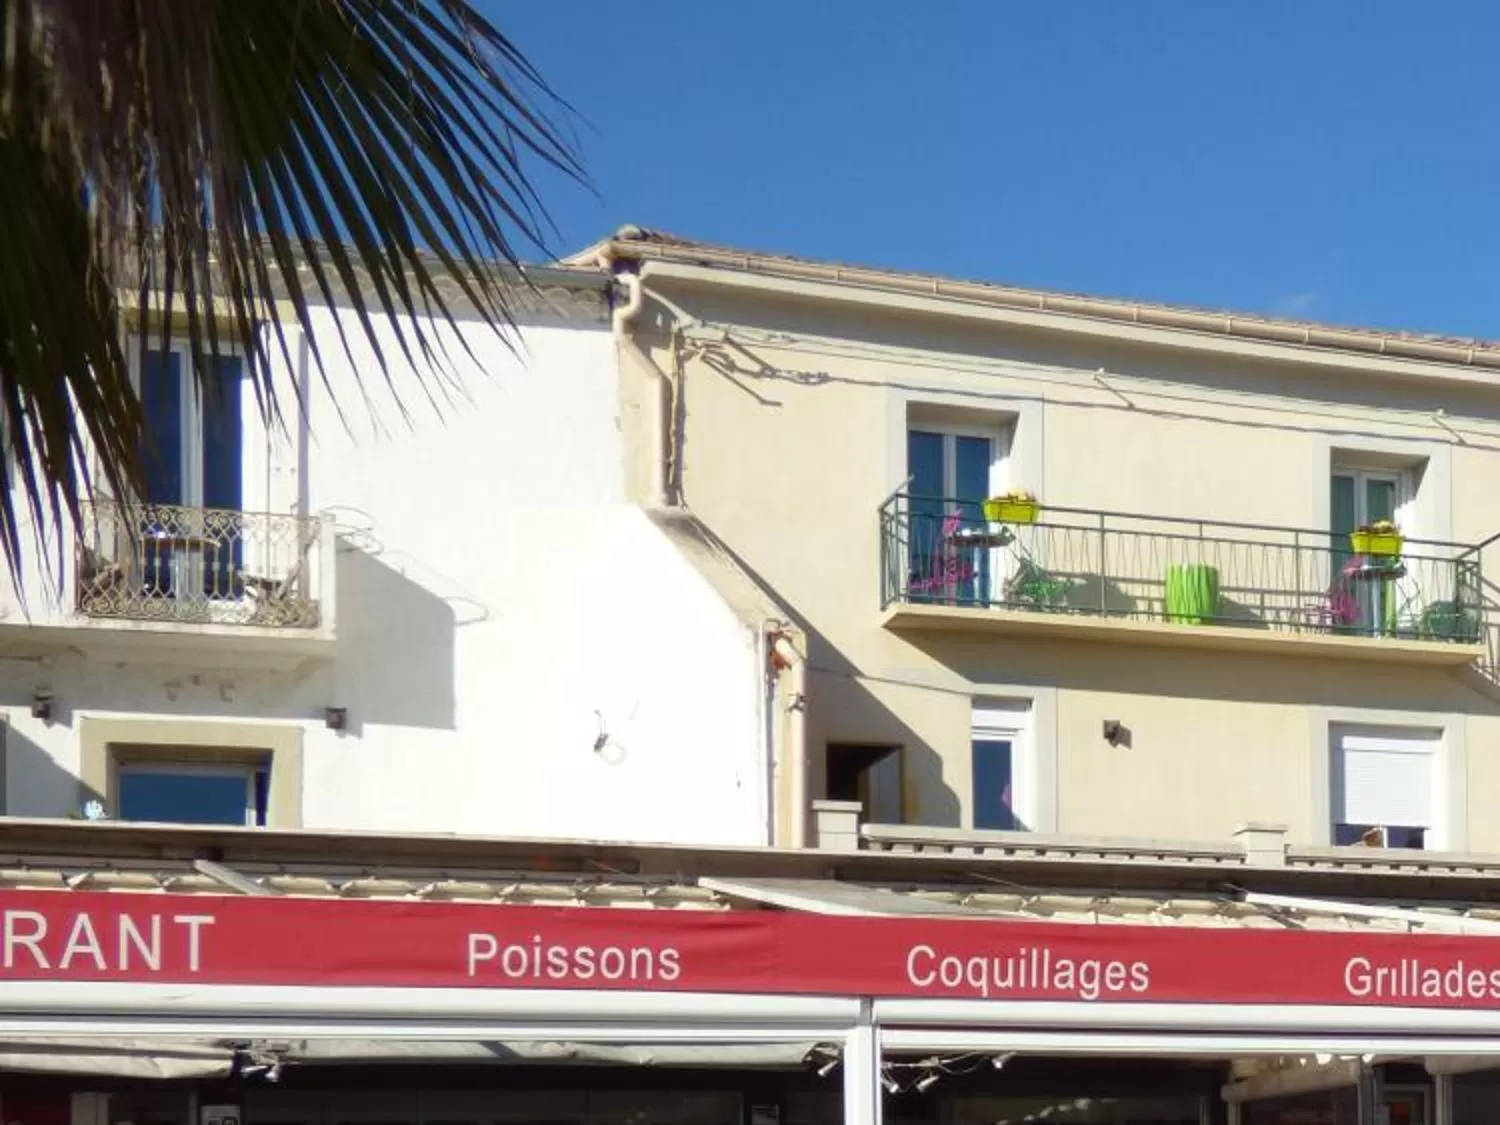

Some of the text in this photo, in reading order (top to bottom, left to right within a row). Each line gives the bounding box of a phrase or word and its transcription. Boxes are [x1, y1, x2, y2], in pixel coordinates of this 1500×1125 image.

[3, 909, 216, 972] RANT
[468, 933, 681, 980] Poissons
[907, 945, 1150, 1000] Coquillages
